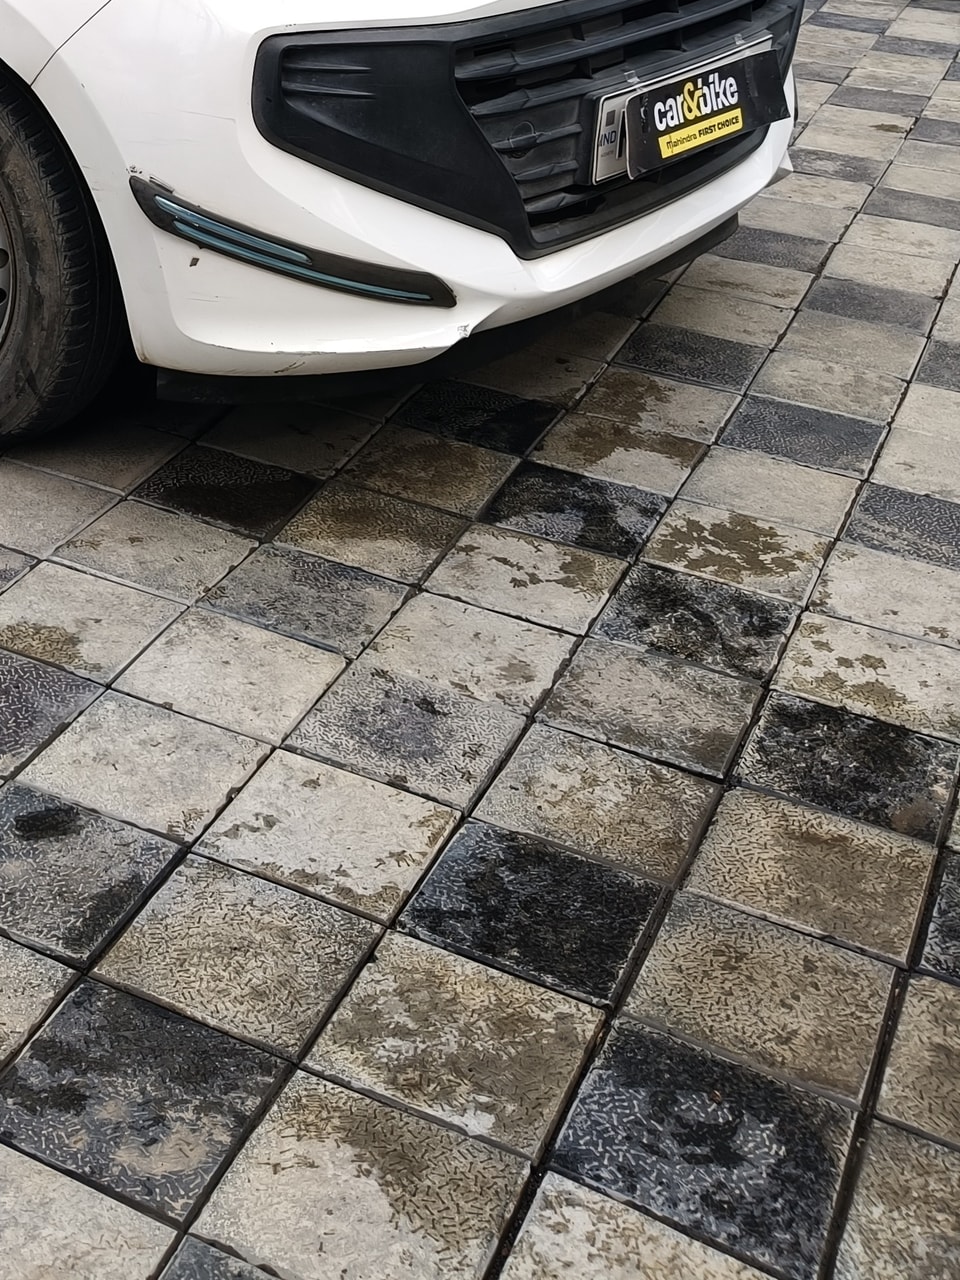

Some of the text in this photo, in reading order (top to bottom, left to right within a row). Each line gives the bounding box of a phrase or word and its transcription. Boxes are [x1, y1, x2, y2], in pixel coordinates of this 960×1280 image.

[653, 73, 739, 132] car&bike
[600, 130, 617, 147] IND
[666, 115, 740, 150] Mahindra FIRST CHOICE
